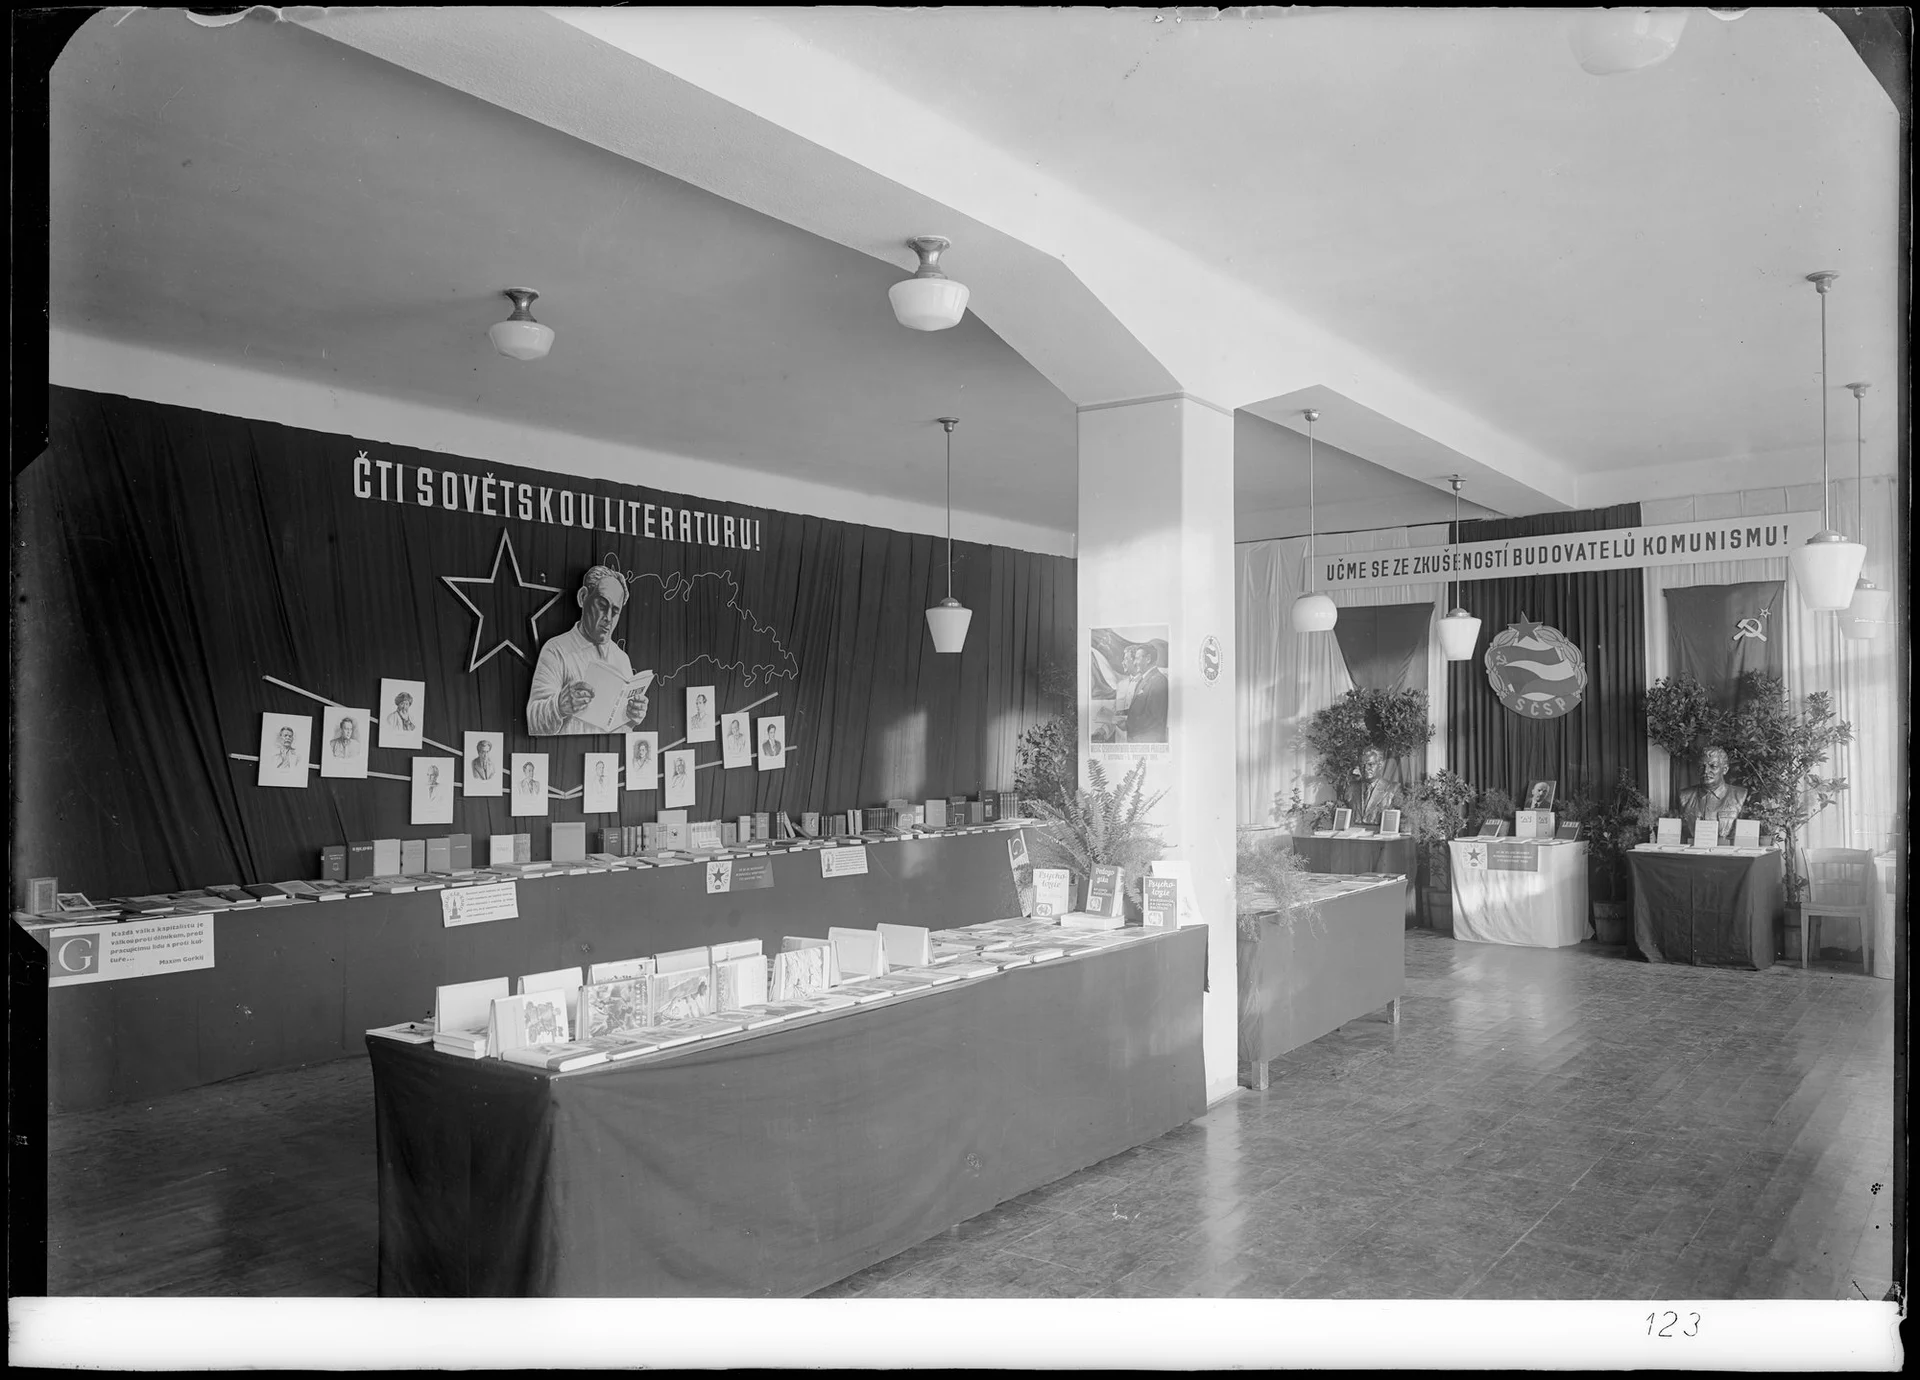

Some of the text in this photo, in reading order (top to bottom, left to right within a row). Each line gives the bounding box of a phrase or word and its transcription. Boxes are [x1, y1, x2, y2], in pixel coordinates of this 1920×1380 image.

[353, 450, 761, 552] ČTI SOVĚTSKOU LITERATURU!
[1326, 525, 1790, 582] UČME SE ZE ZKUŠENOSTÍ BUDOVATELŮ KOMUNISMU!
[1514, 697, 1567, 716] SČSP
[134, 936, 153, 944] proti
[186, 930, 204, 938] proti
[171, 940, 189, 948] proti
[58, 937, 93, 972] G
